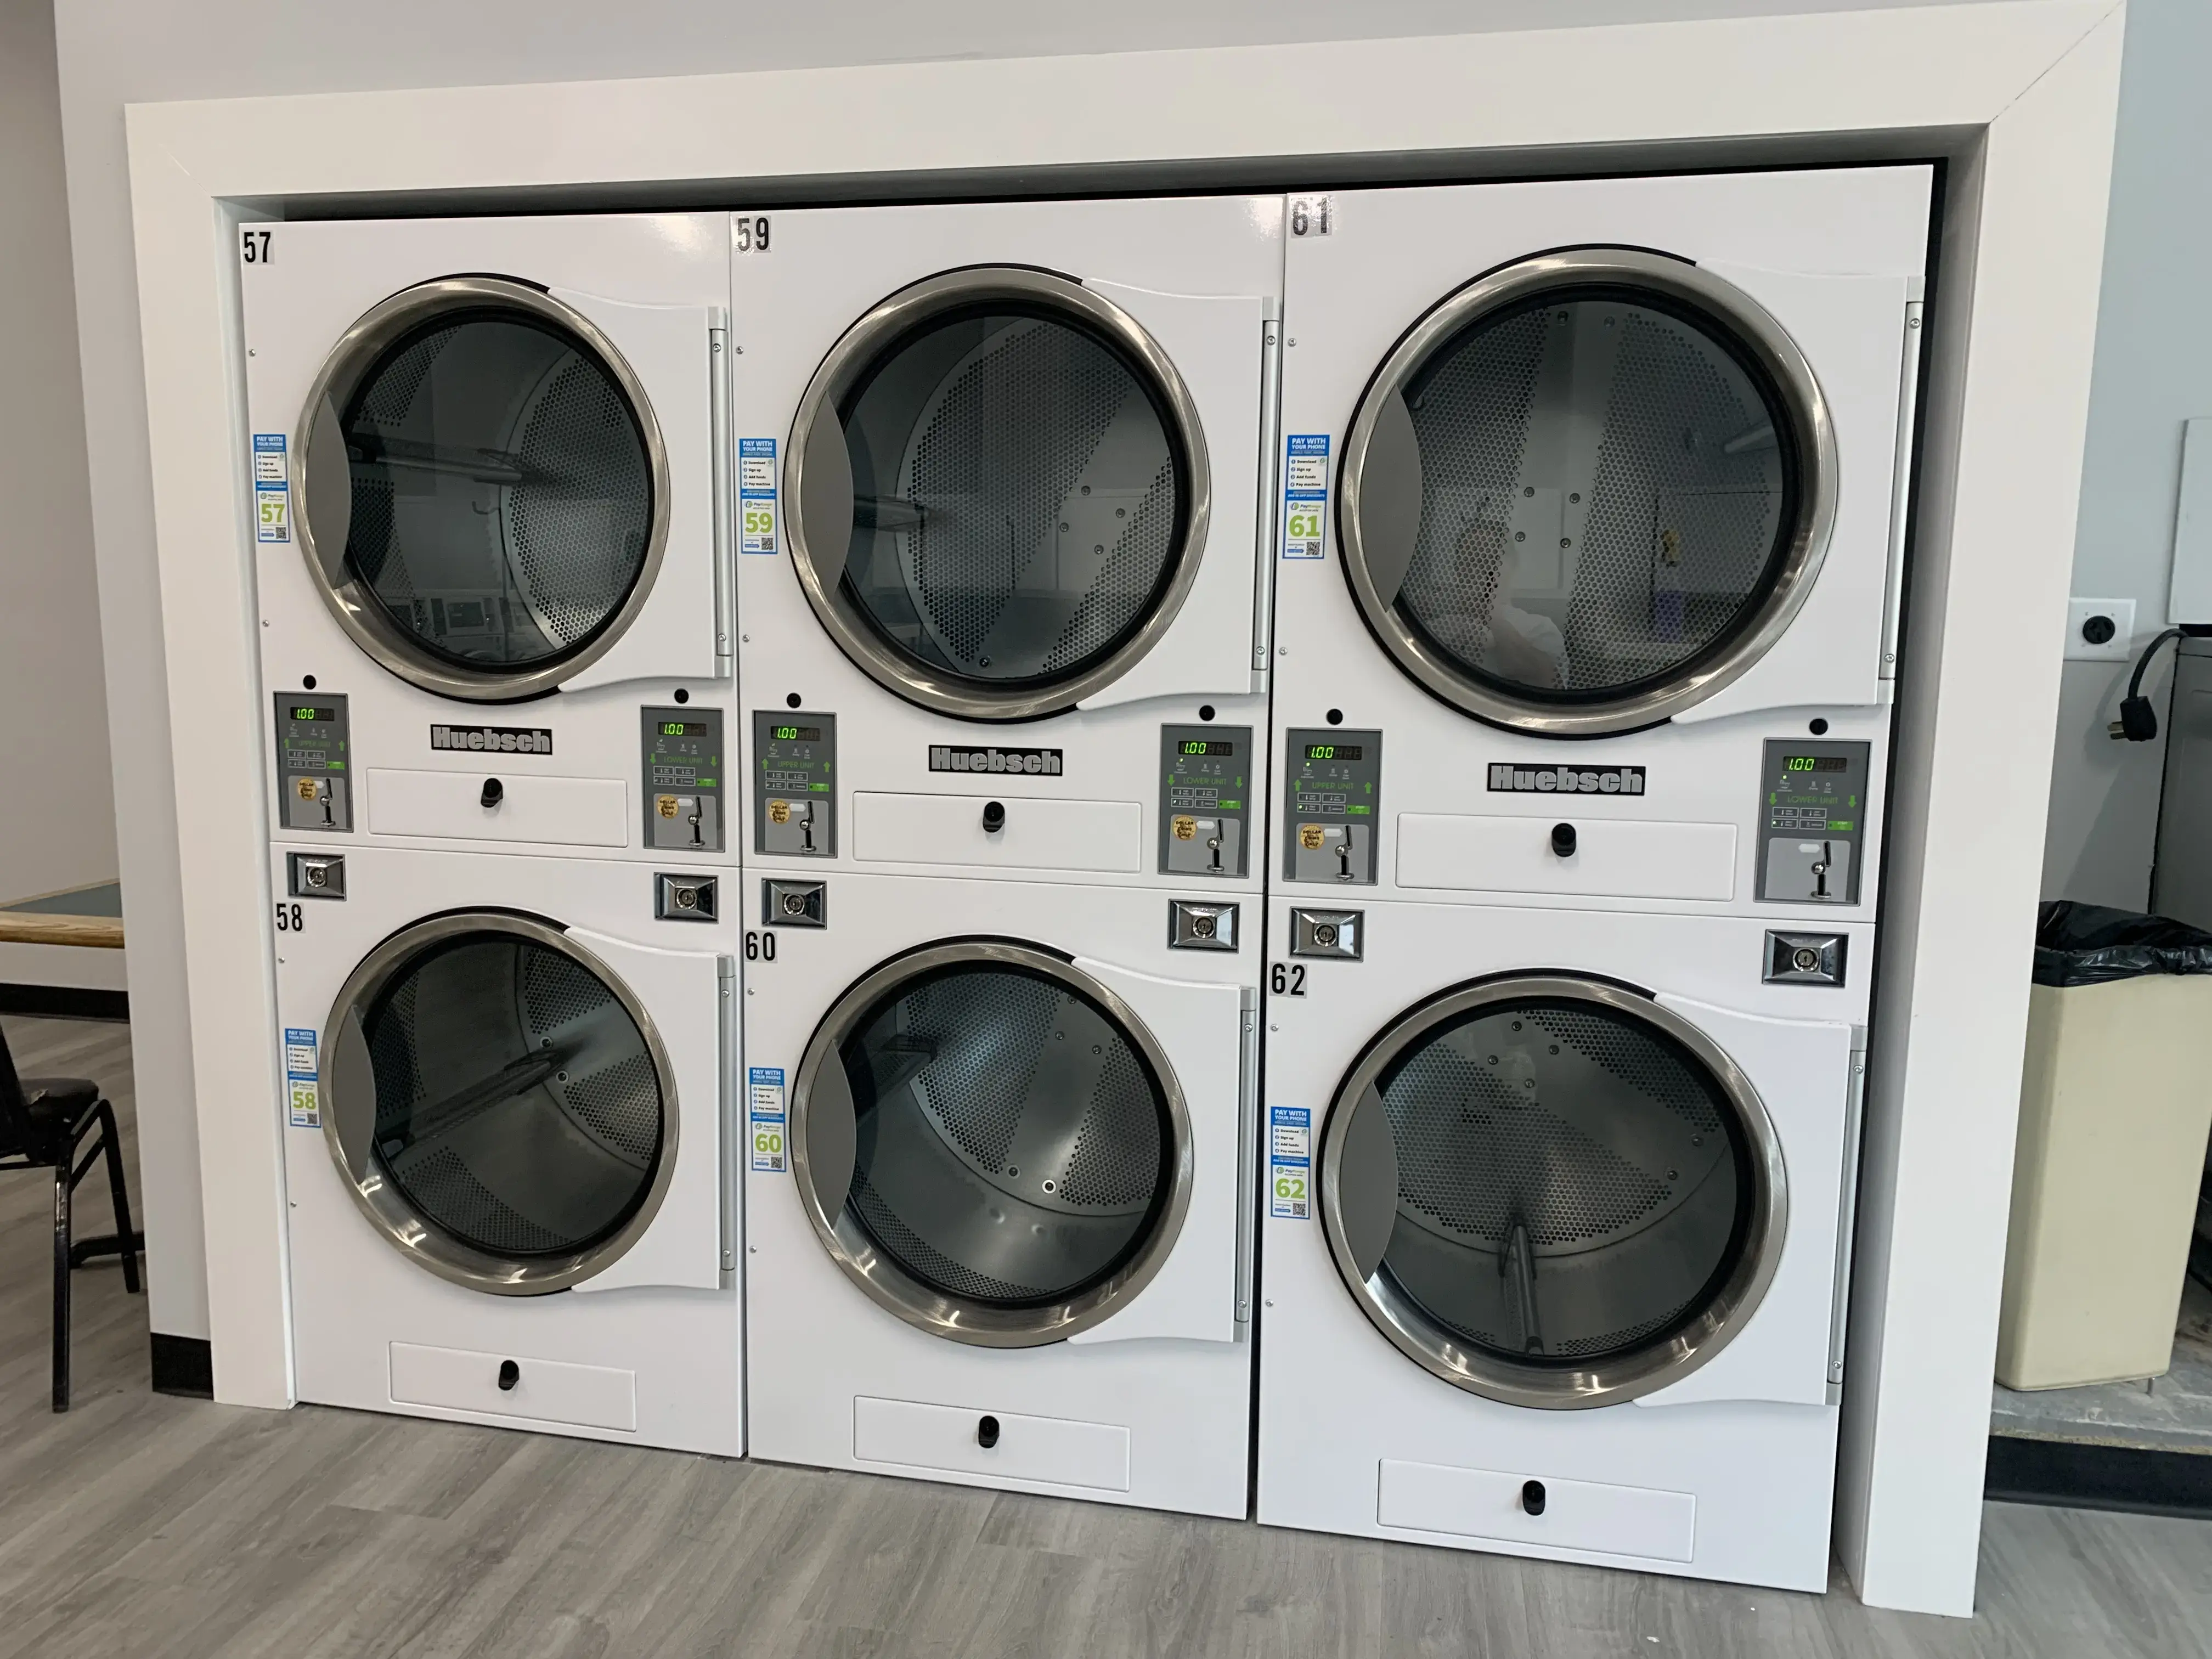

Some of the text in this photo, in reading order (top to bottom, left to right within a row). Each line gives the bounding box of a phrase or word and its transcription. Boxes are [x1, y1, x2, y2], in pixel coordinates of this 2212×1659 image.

[1293, 198, 1327, 235] 61
[737, 217, 769, 251] 59
[244, 232, 271, 263] 57
[261, 504, 285, 522] 57
[745, 512, 772, 533] 59
[1289, 515, 1320, 537] 61
[297, 708, 314, 719] 1.00
[432, 726, 550, 752] Huebsch
[664, 724, 684, 735] 1.00
[777, 727, 797, 739] 1.00
[1184, 742, 1206, 754] 1.00
[1311, 747, 1334, 758] 1.00
[931, 748, 1060, 773] Huebsch
[1789, 758, 1814, 771] 1.00
[1490, 765, 1643, 792] Huebsch
[276, 903, 303, 932] 58
[746, 932, 775, 961] 60
[1272, 963, 1305, 996] 62
[293, 1091, 316, 1110] 58
[755, 1133, 782, 1153] 60
[1276, 1178, 1306, 1199] 62
